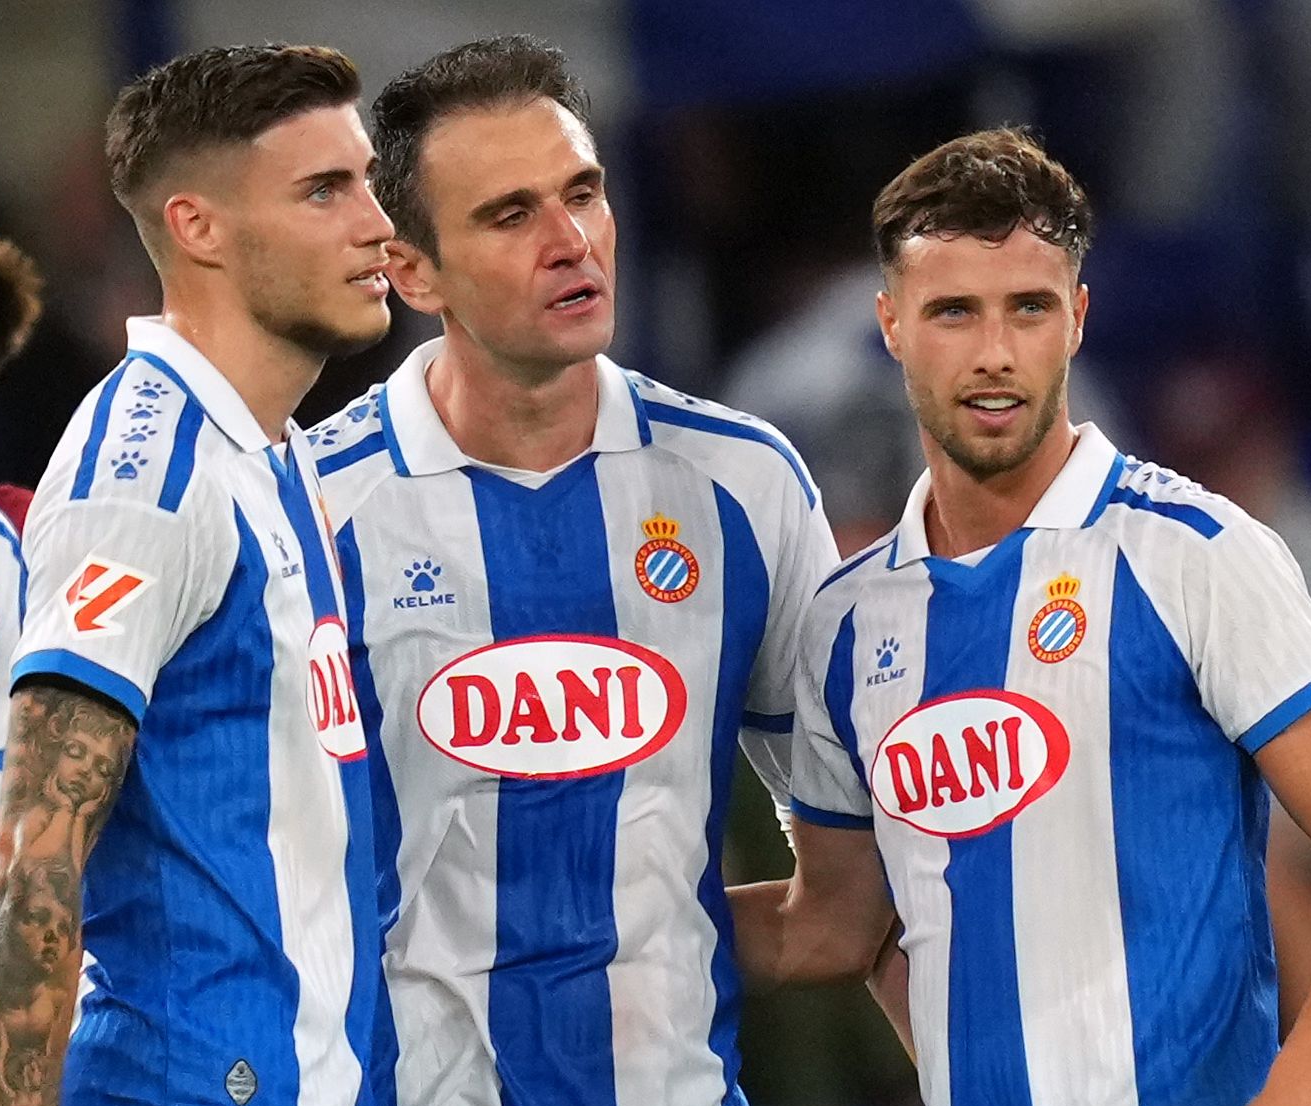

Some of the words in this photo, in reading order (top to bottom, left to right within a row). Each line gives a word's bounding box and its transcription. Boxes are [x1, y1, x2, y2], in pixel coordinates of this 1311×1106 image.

[393, 593, 456, 608] KELME
[447, 666, 644, 748] DANI
[885, 717, 1024, 814] DANI
